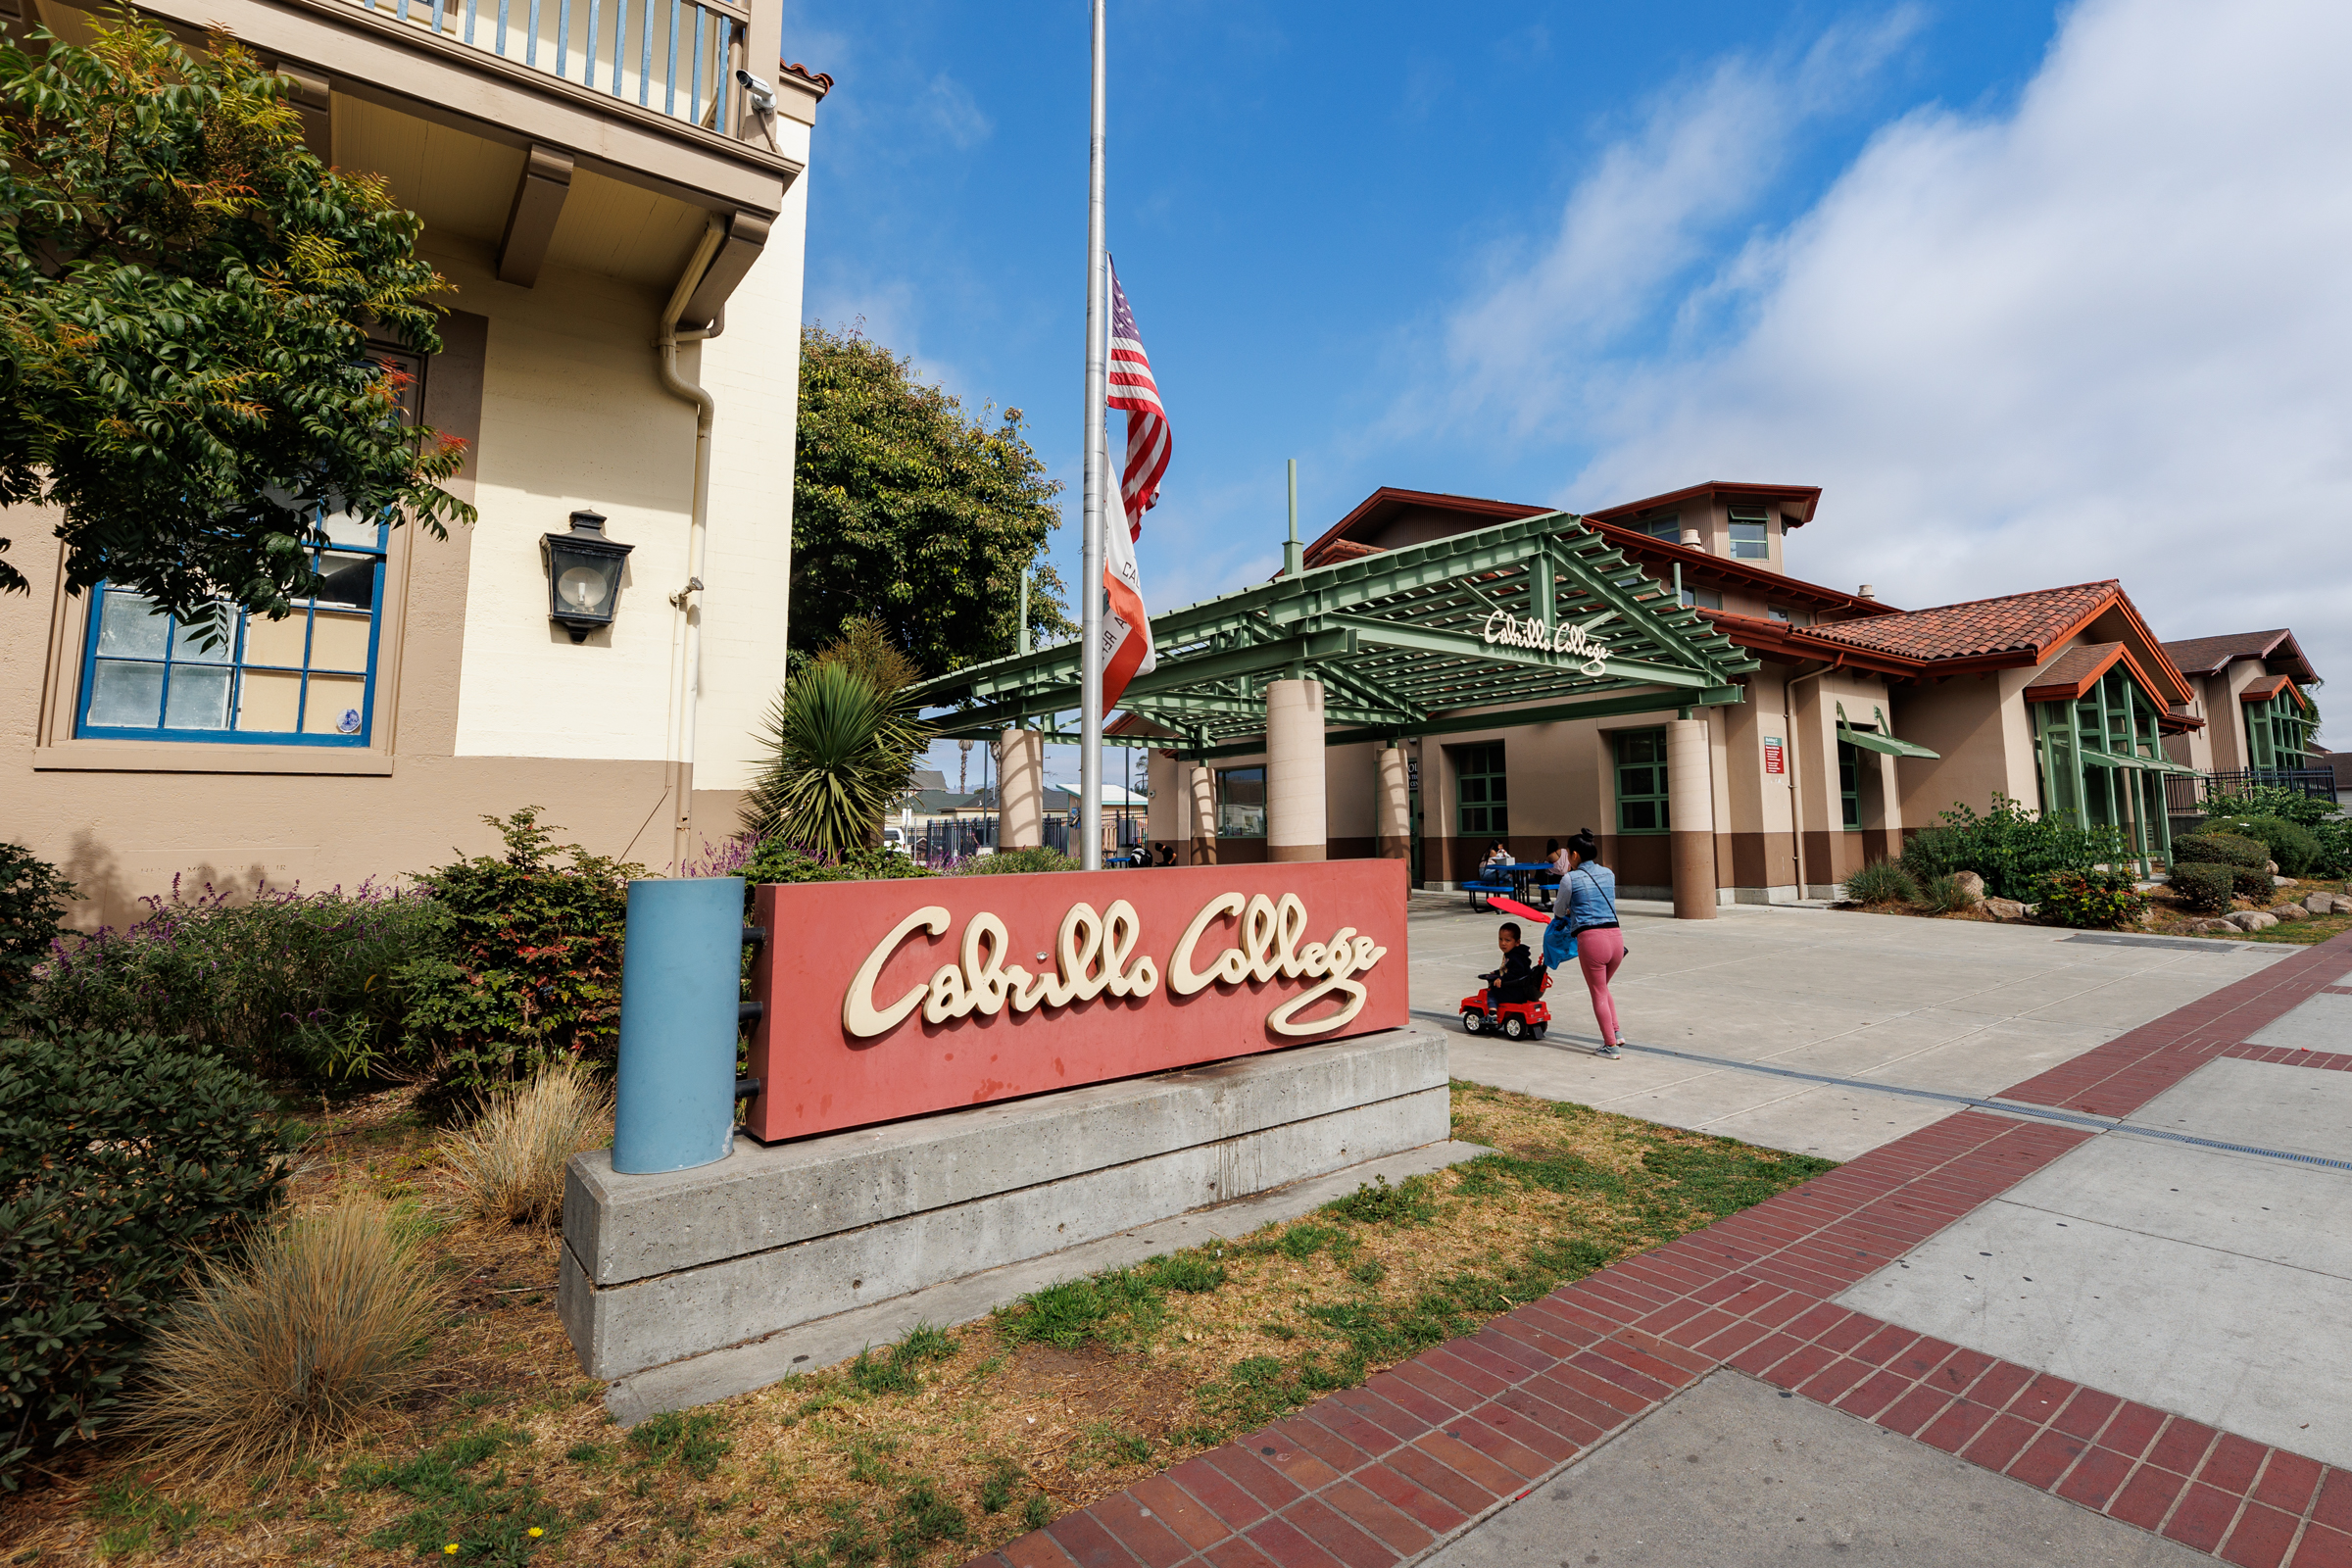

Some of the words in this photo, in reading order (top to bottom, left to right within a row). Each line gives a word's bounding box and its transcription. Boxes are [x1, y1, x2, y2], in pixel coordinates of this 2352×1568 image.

[1484, 610, 1551, 652] Cabrillo
[1553, 621, 1611, 677] College
[842, 899, 1159, 1038] Cabrillo
[1167, 891, 1388, 1036] College
